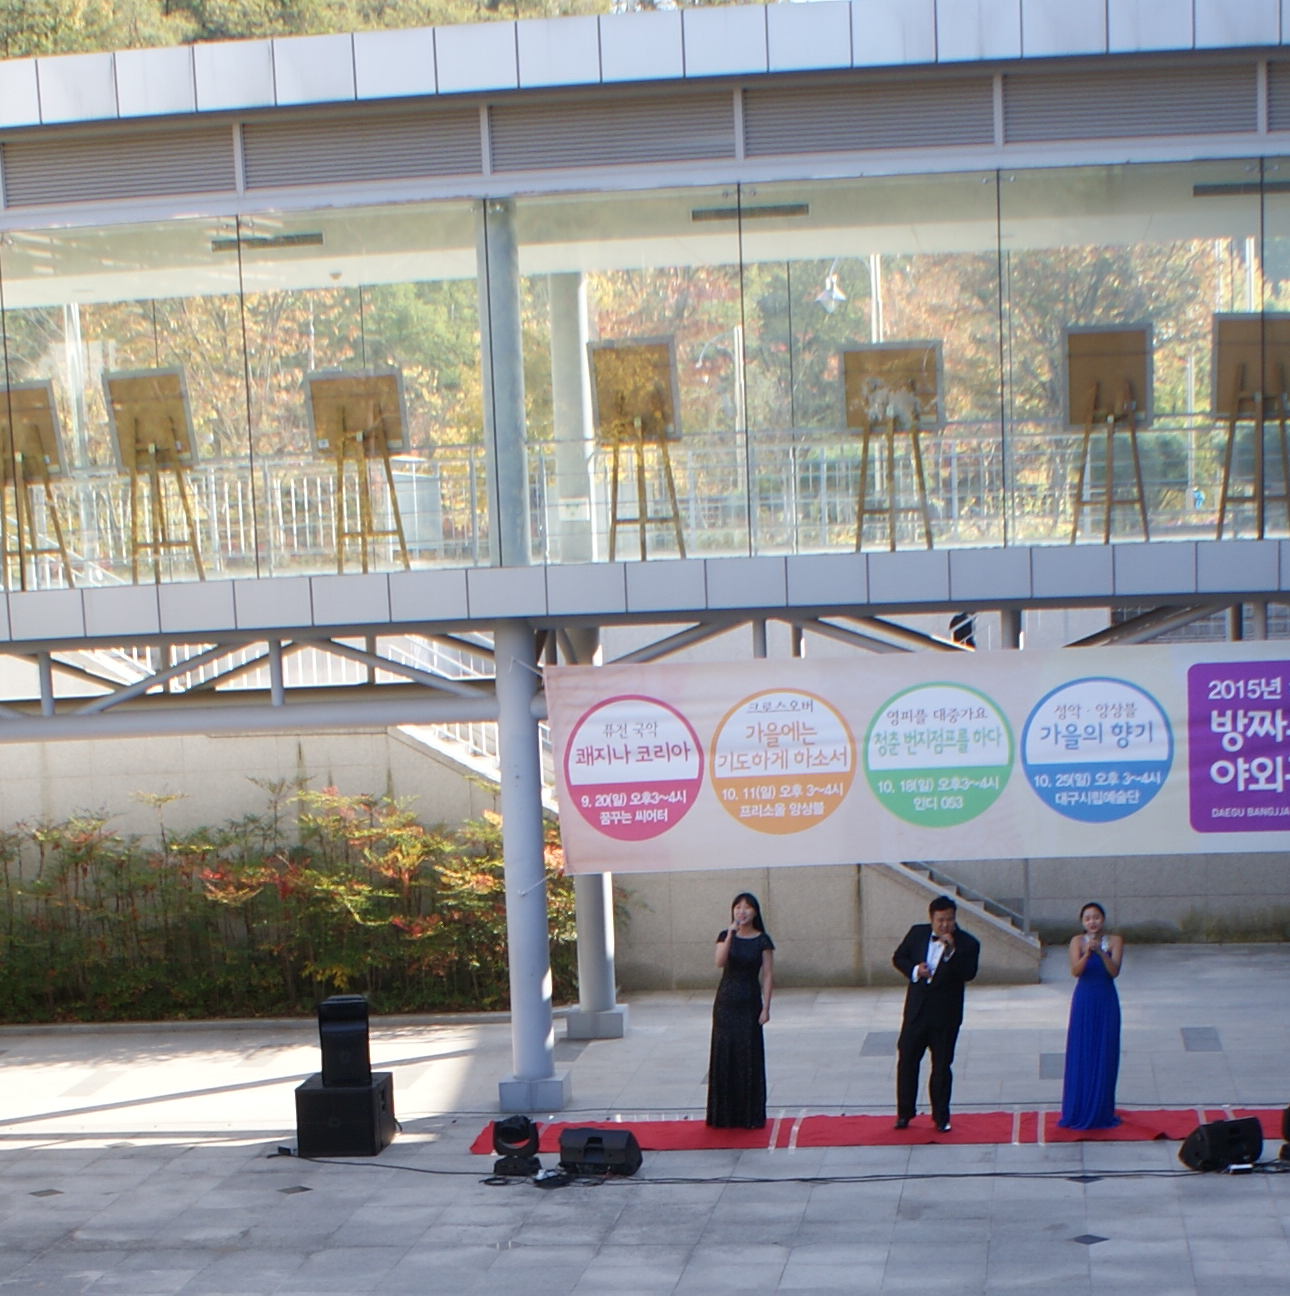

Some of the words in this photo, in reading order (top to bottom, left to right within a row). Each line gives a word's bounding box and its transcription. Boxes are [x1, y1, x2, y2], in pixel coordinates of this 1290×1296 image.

[1208, 676, 1282, 700] 2015년
[747, 699, 814, 714] 크로스오버
[933, 707, 988, 724] 대중가요
[1053, 703, 1082, 720] 성악
[1095, 702, 1138, 719] 앙상블
[633, 720, 658, 738] 국악
[745, 720, 818, 748] 가을에는
[1040, 720, 1103, 750] 가을의
[1111, 720, 1153, 749] 향기
[873, 729, 900, 758] 청춘
[904, 727, 969, 756] 번지점프를
[972, 726, 1002, 749] 하다
[575, 742, 632, 767] 쾌지나
[635, 740, 691, 763] 코리아
[717, 748, 789, 772] 기도하게
[794, 745, 848, 769] 하소서
[1034, 774, 1052, 788] 10.
[1094, 771, 1120, 786] 오후
[594, 792, 627, 808] 20(일)
[721, 787, 739, 801] 10.
[742, 785, 776, 800] 11(일)
[779, 784, 803, 798] 오후
[635, 808, 668, 824] 씨어터
[1211, 807, 1245, 818] DAEGU
[1246, 806, 1290, 817] BANGJJA
